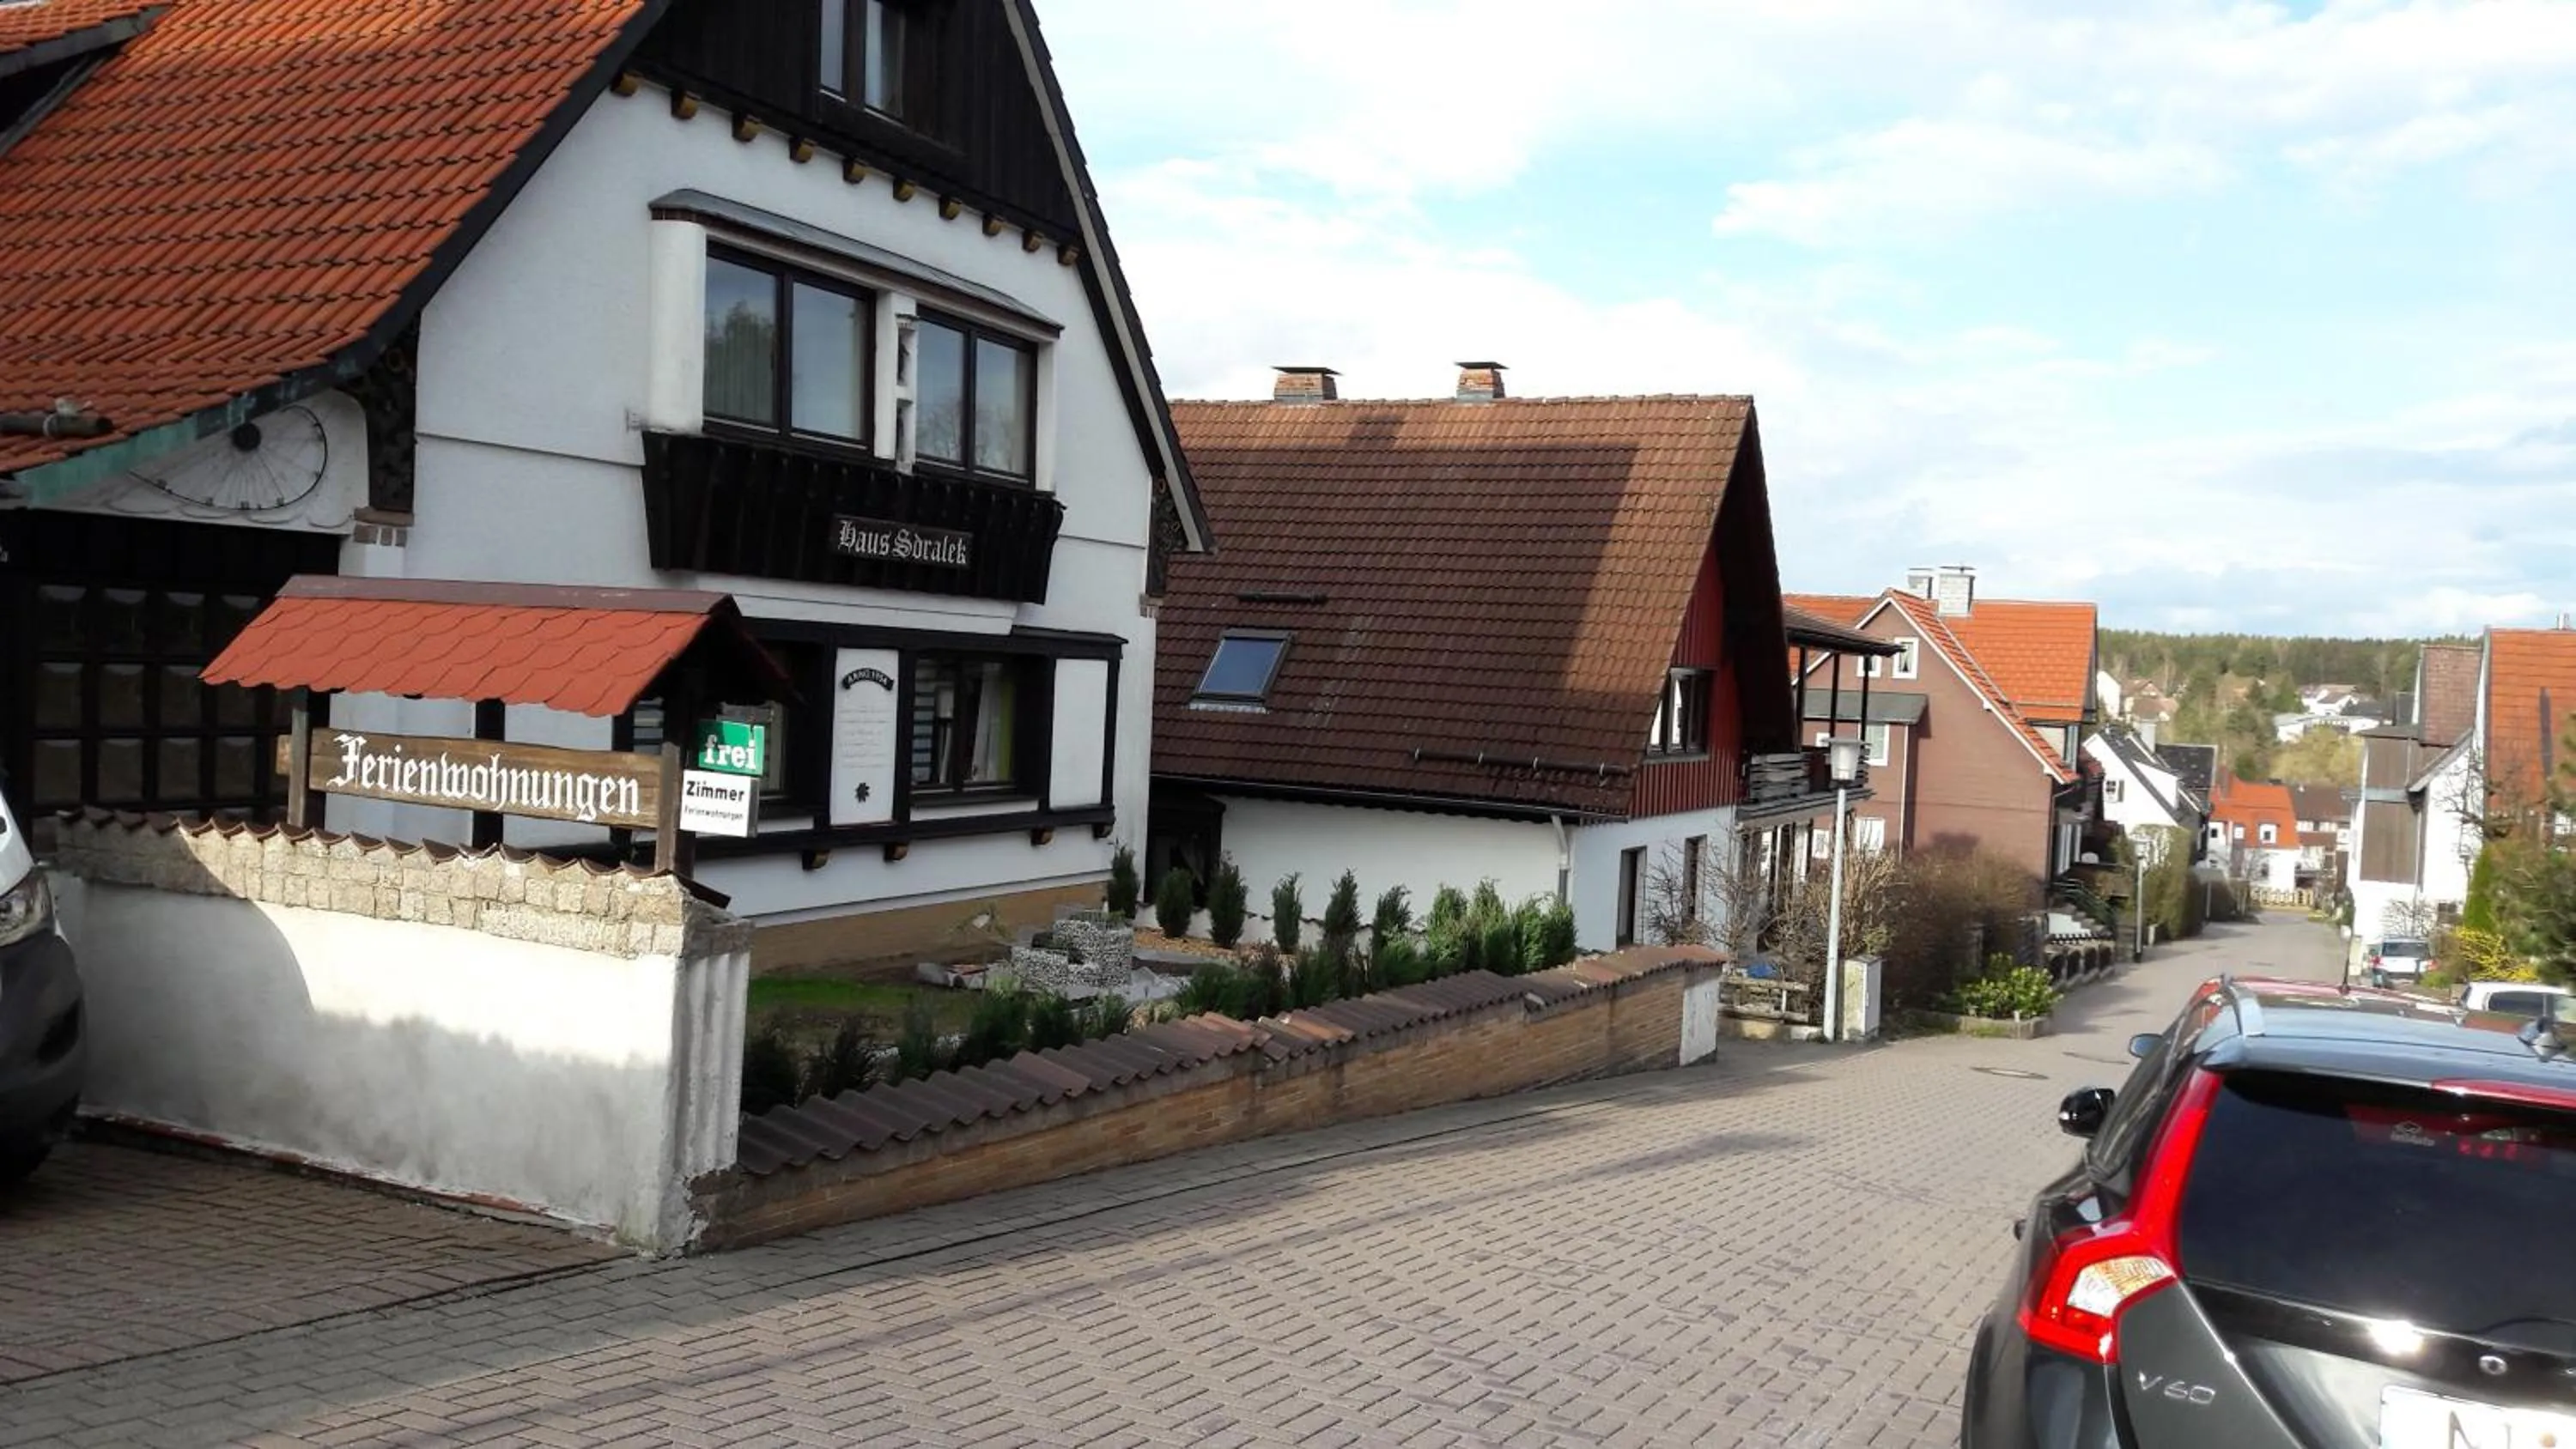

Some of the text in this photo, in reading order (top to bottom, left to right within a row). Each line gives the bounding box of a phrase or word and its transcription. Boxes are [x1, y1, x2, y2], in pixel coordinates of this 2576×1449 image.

[837, 519, 967, 565] Haus Sdralek
[703, 734, 756, 770] frei
[326, 734, 640, 822] Ferienwohnungen
[686, 779, 744, 802] Zimmer
[2138, 1371, 2215, 1404] V60
